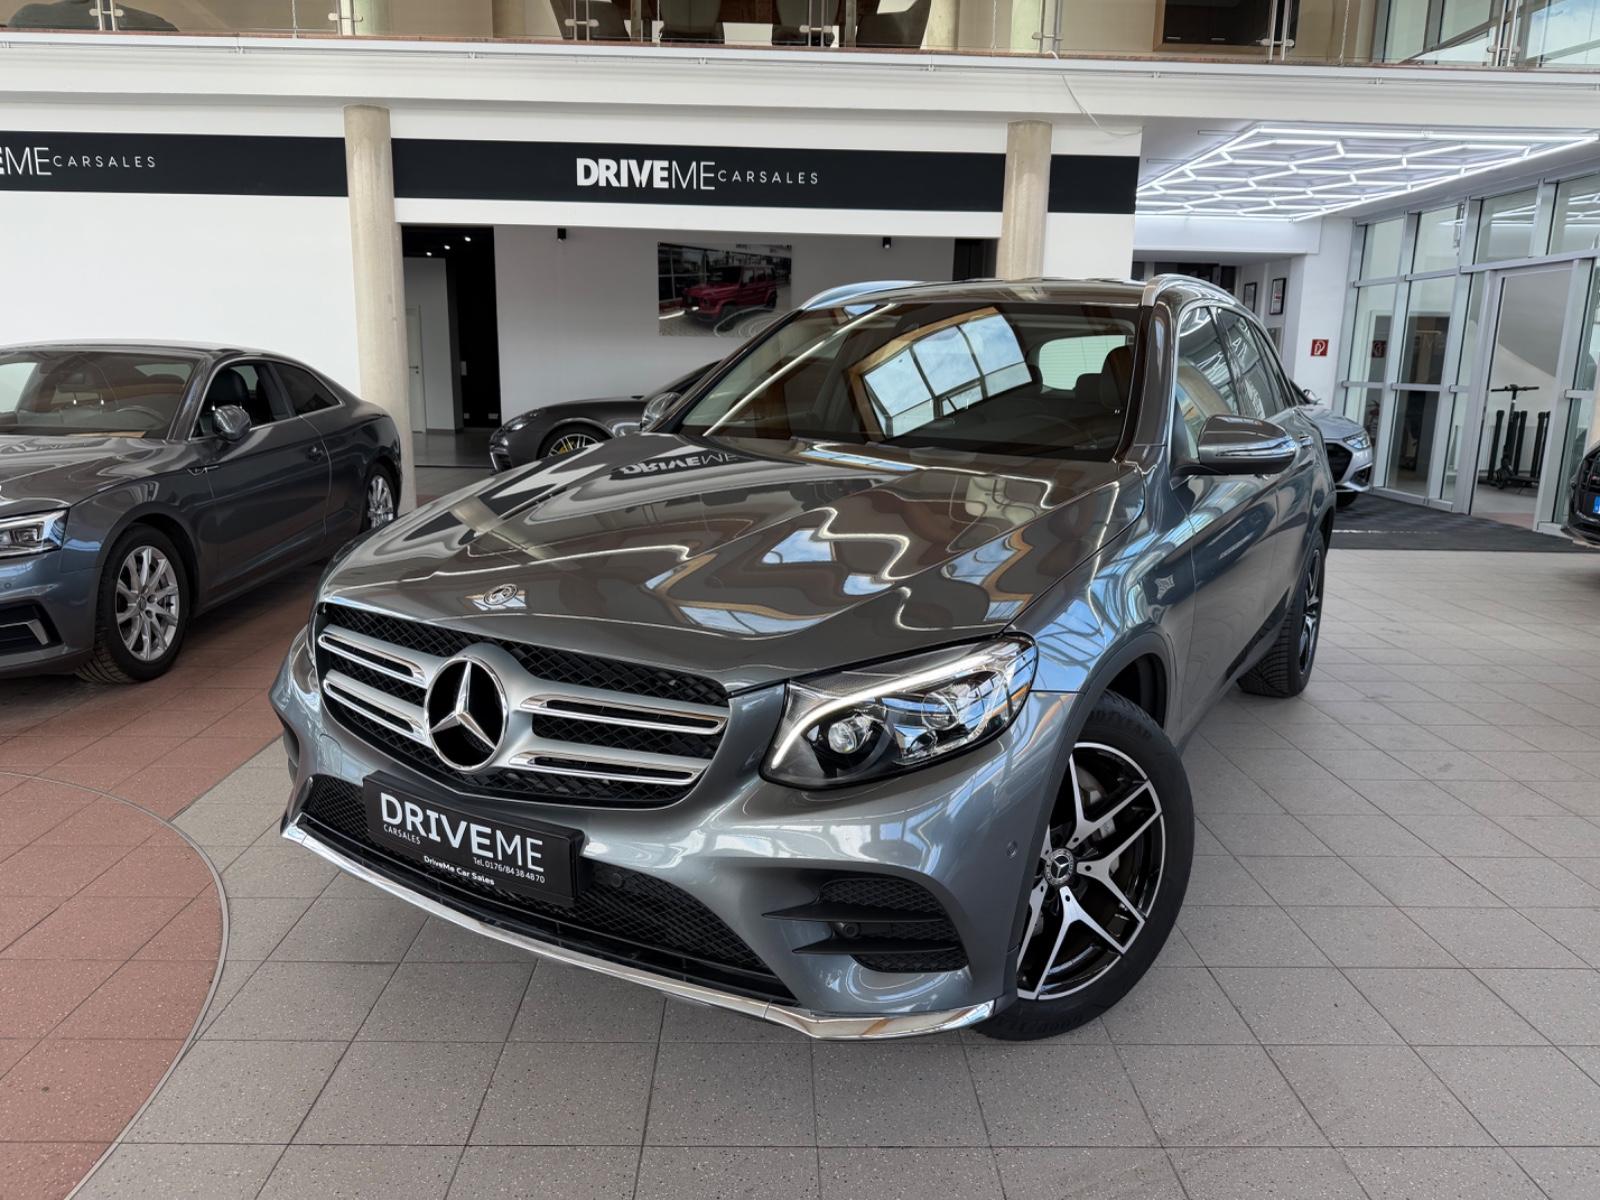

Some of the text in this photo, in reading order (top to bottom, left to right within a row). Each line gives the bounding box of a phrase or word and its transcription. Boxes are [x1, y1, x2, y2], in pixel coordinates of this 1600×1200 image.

[53, 156, 156, 168] CARSALES
[718, 169, 818, 185] CARSALES
[380, 792, 544, 872] DRIVEME
[383, 824, 421, 845] CARSALES
[423, 855, 496, 886] DriveMe Car Sales
